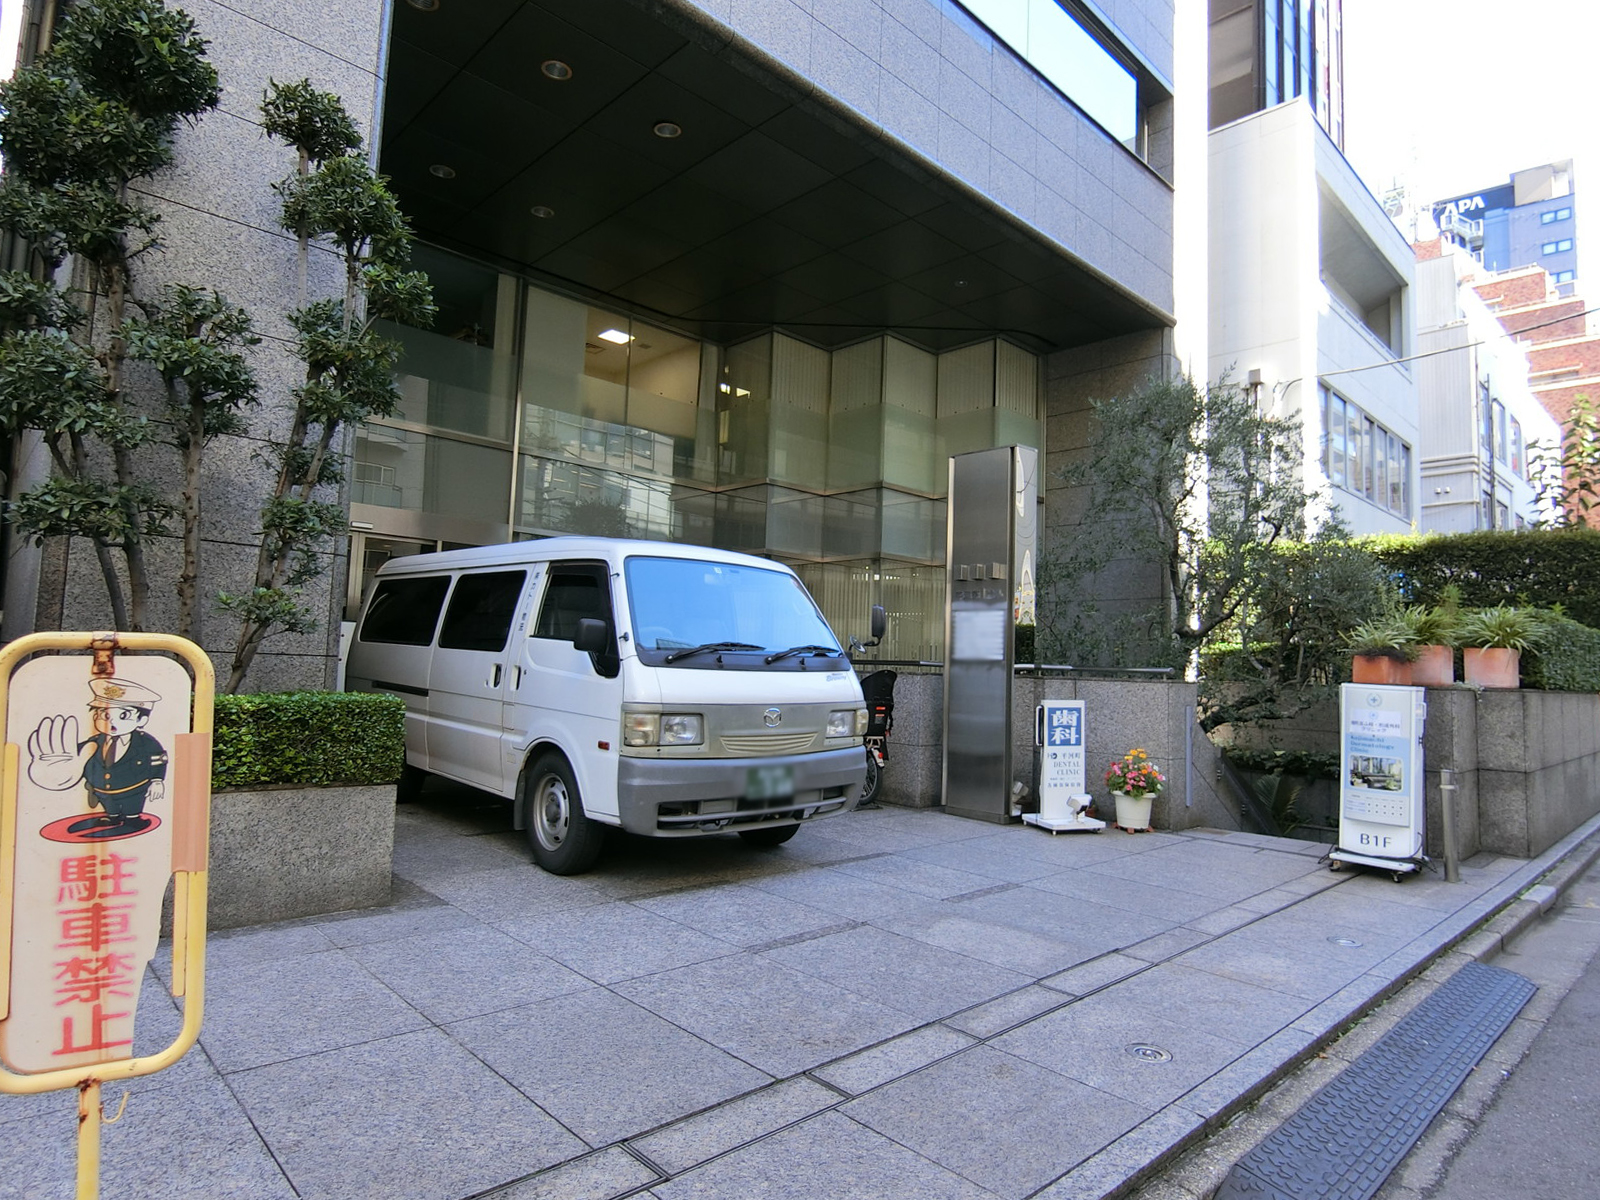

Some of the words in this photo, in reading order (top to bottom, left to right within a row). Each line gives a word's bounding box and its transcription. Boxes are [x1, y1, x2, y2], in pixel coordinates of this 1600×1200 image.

[1443, 196, 1486, 217] APA
[1050, 709, 1080, 745] 歯科
[1360, 833, 1392, 848] B1F
[51, 854, 139, 1057] 駐車禁止
